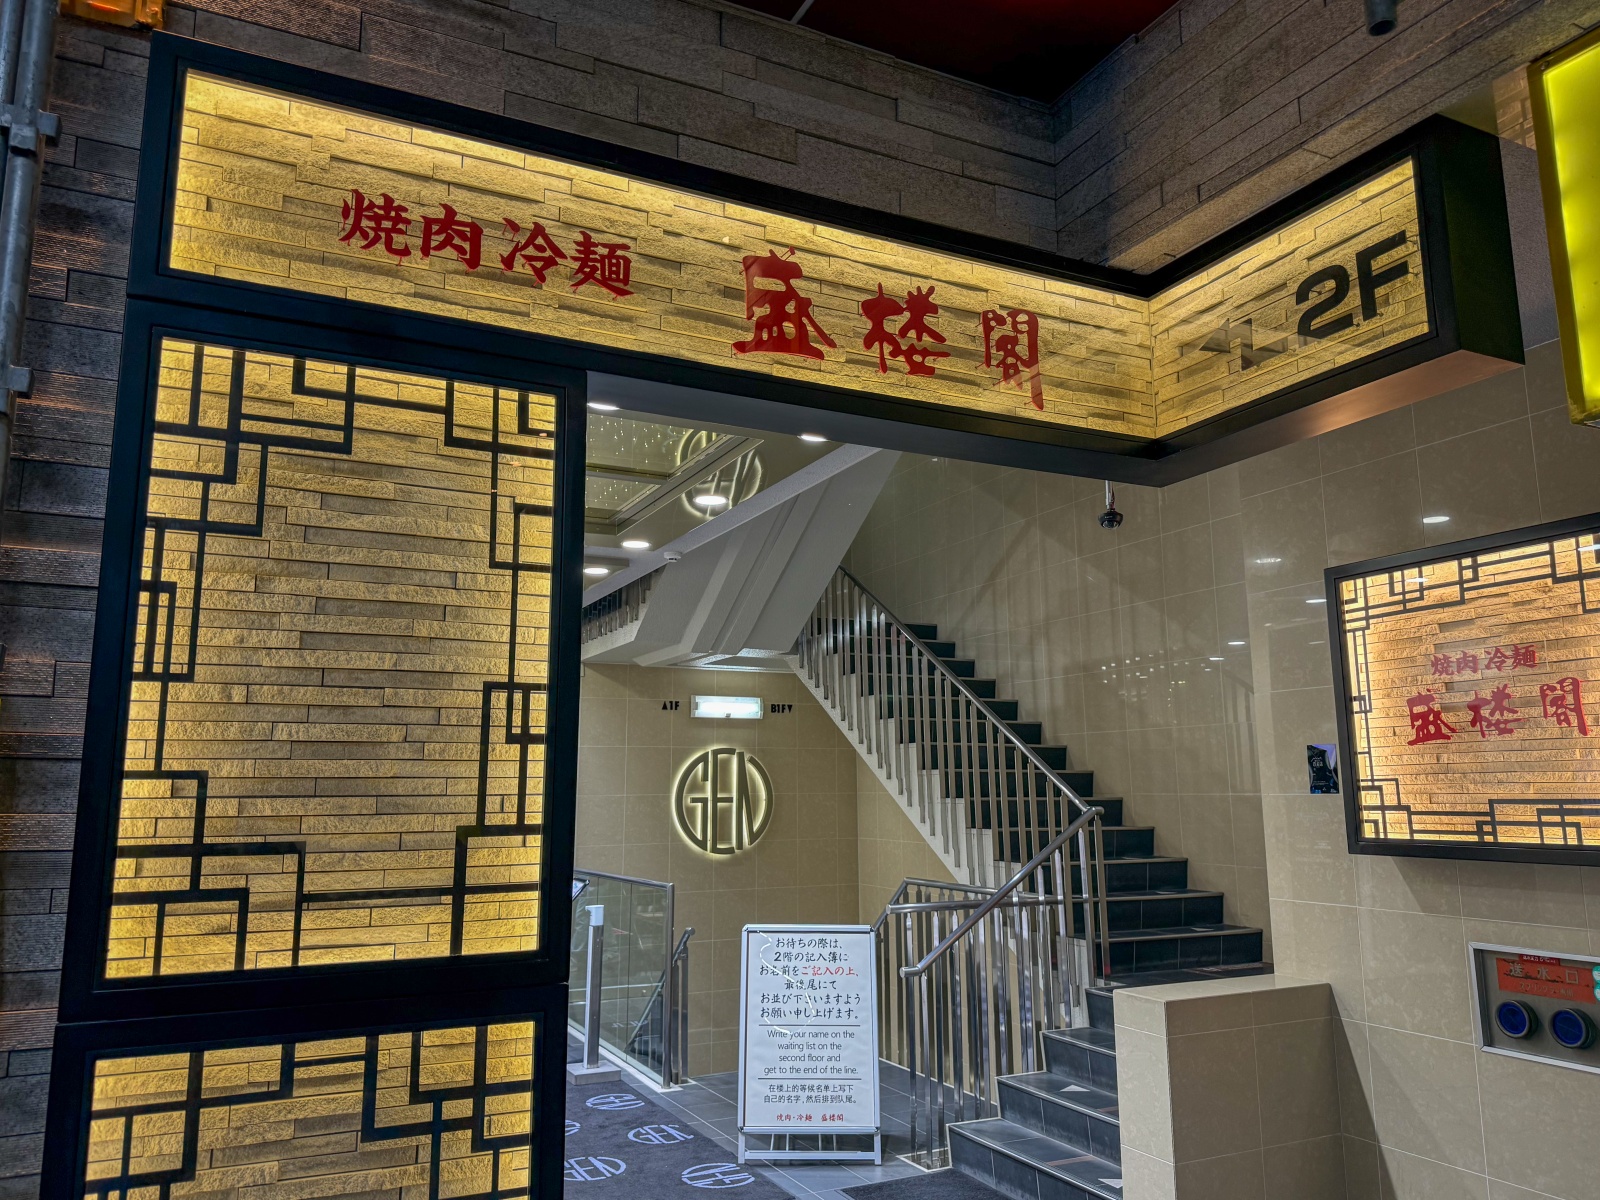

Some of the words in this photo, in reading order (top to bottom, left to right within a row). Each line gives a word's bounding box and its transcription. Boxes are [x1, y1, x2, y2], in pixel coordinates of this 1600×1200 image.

[339, 188, 635, 298] 焼肉冷麺
[1295, 229, 1409, 340] 2F
[1430, 644, 1538, 676] 焼肉冷麺
[668, 700, 680, 710] 1F
[770, 704, 786, 714] B1F
[674, 747, 774, 855] GEN
[775, 938, 843, 949] お待ちの際は、
[774, 951, 850, 964] 2階の記入簿に
[1509, 962, 1579, 984] 送水口
[760, 1006, 859, 1020] お願い申し上げます。
[766, 1029, 788, 1038] Write
[790, 1031, 806, 1040] your
[842, 1030, 855, 1038] the
[778, 1042, 804, 1052] waiting
[806, 1042, 816, 1050] list
[830, 1042, 842, 1050] the
[778, 1054, 806, 1062] second
[808, 1054, 825, 1062] floor
[826, 1054, 841, 1062] and
[764, 1066, 776, 1076] get
[778, 1066, 788, 1074] to
[789, 1065, 802, 1074] the
[803, 1065, 818, 1074] end
[819, 1065, 829, 1074] of
[830, 1065, 842, 1074] the
[844, 1065, 858, 1074] line.
[768, 1084, 854, 1094] 在楼上的等候名单上写下
